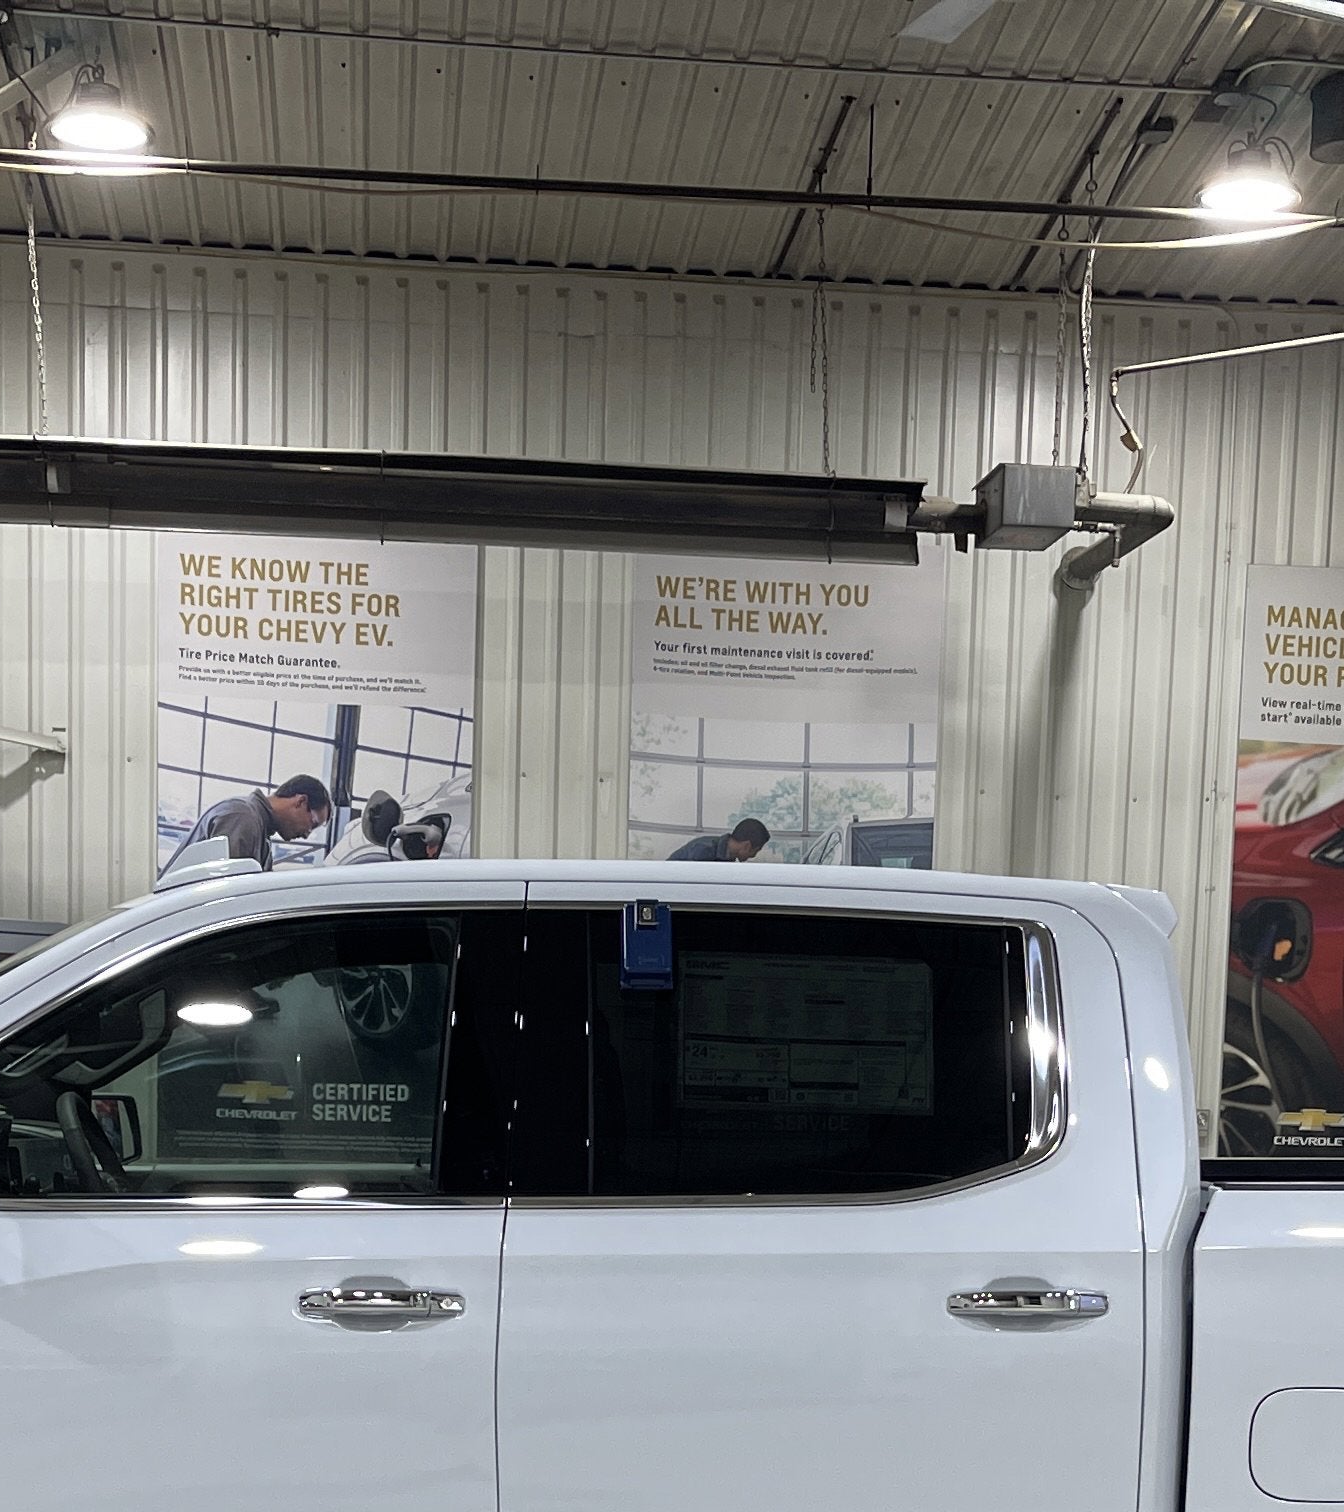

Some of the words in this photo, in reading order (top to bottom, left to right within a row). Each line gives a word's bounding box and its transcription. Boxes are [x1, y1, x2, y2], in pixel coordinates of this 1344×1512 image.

[179, 553, 222, 578] WE
[231, 557, 310, 583] KNOW
[319, 561, 369, 586] THE
[179, 582, 259, 610] RIGHT
[267, 588, 342, 615] TIRES
[351, 593, 400, 618] FOR
[656, 575, 737, 603] WE'RE
[745, 580, 811, 605] WITH
[819, 583, 870, 607] YOU
[179, 612, 248, 639] YOUR
[258, 617, 347, 645] CHEVY
[355, 623, 394, 647] EV.
[654, 605, 702, 630] ALL
[711, 608, 760, 632] THE
[768, 612, 828, 635] WAY.
[179, 647, 202, 660] Tire
[205, 650, 235, 662] Price
[238, 652, 274, 665] Match
[277, 655, 341, 669] Guarantee.
[654, 640, 679, 653] Your
[682, 642, 708, 655] first
[710, 645, 783, 659] maintenance
[786, 648, 810, 660] visit
[813, 649, 822, 660] is
[1263, 662, 1327, 687] YOUR
[1261, 697, 1287, 710] View
[1290, 699, 1341, 713] real-time
[1294, 712, 1342, 727] available
[312, 1083, 410, 1103] CERTIFIED
[215, 1108, 299, 1121] CHEVROLET
[311, 1104, 392, 1123] SERVICE
